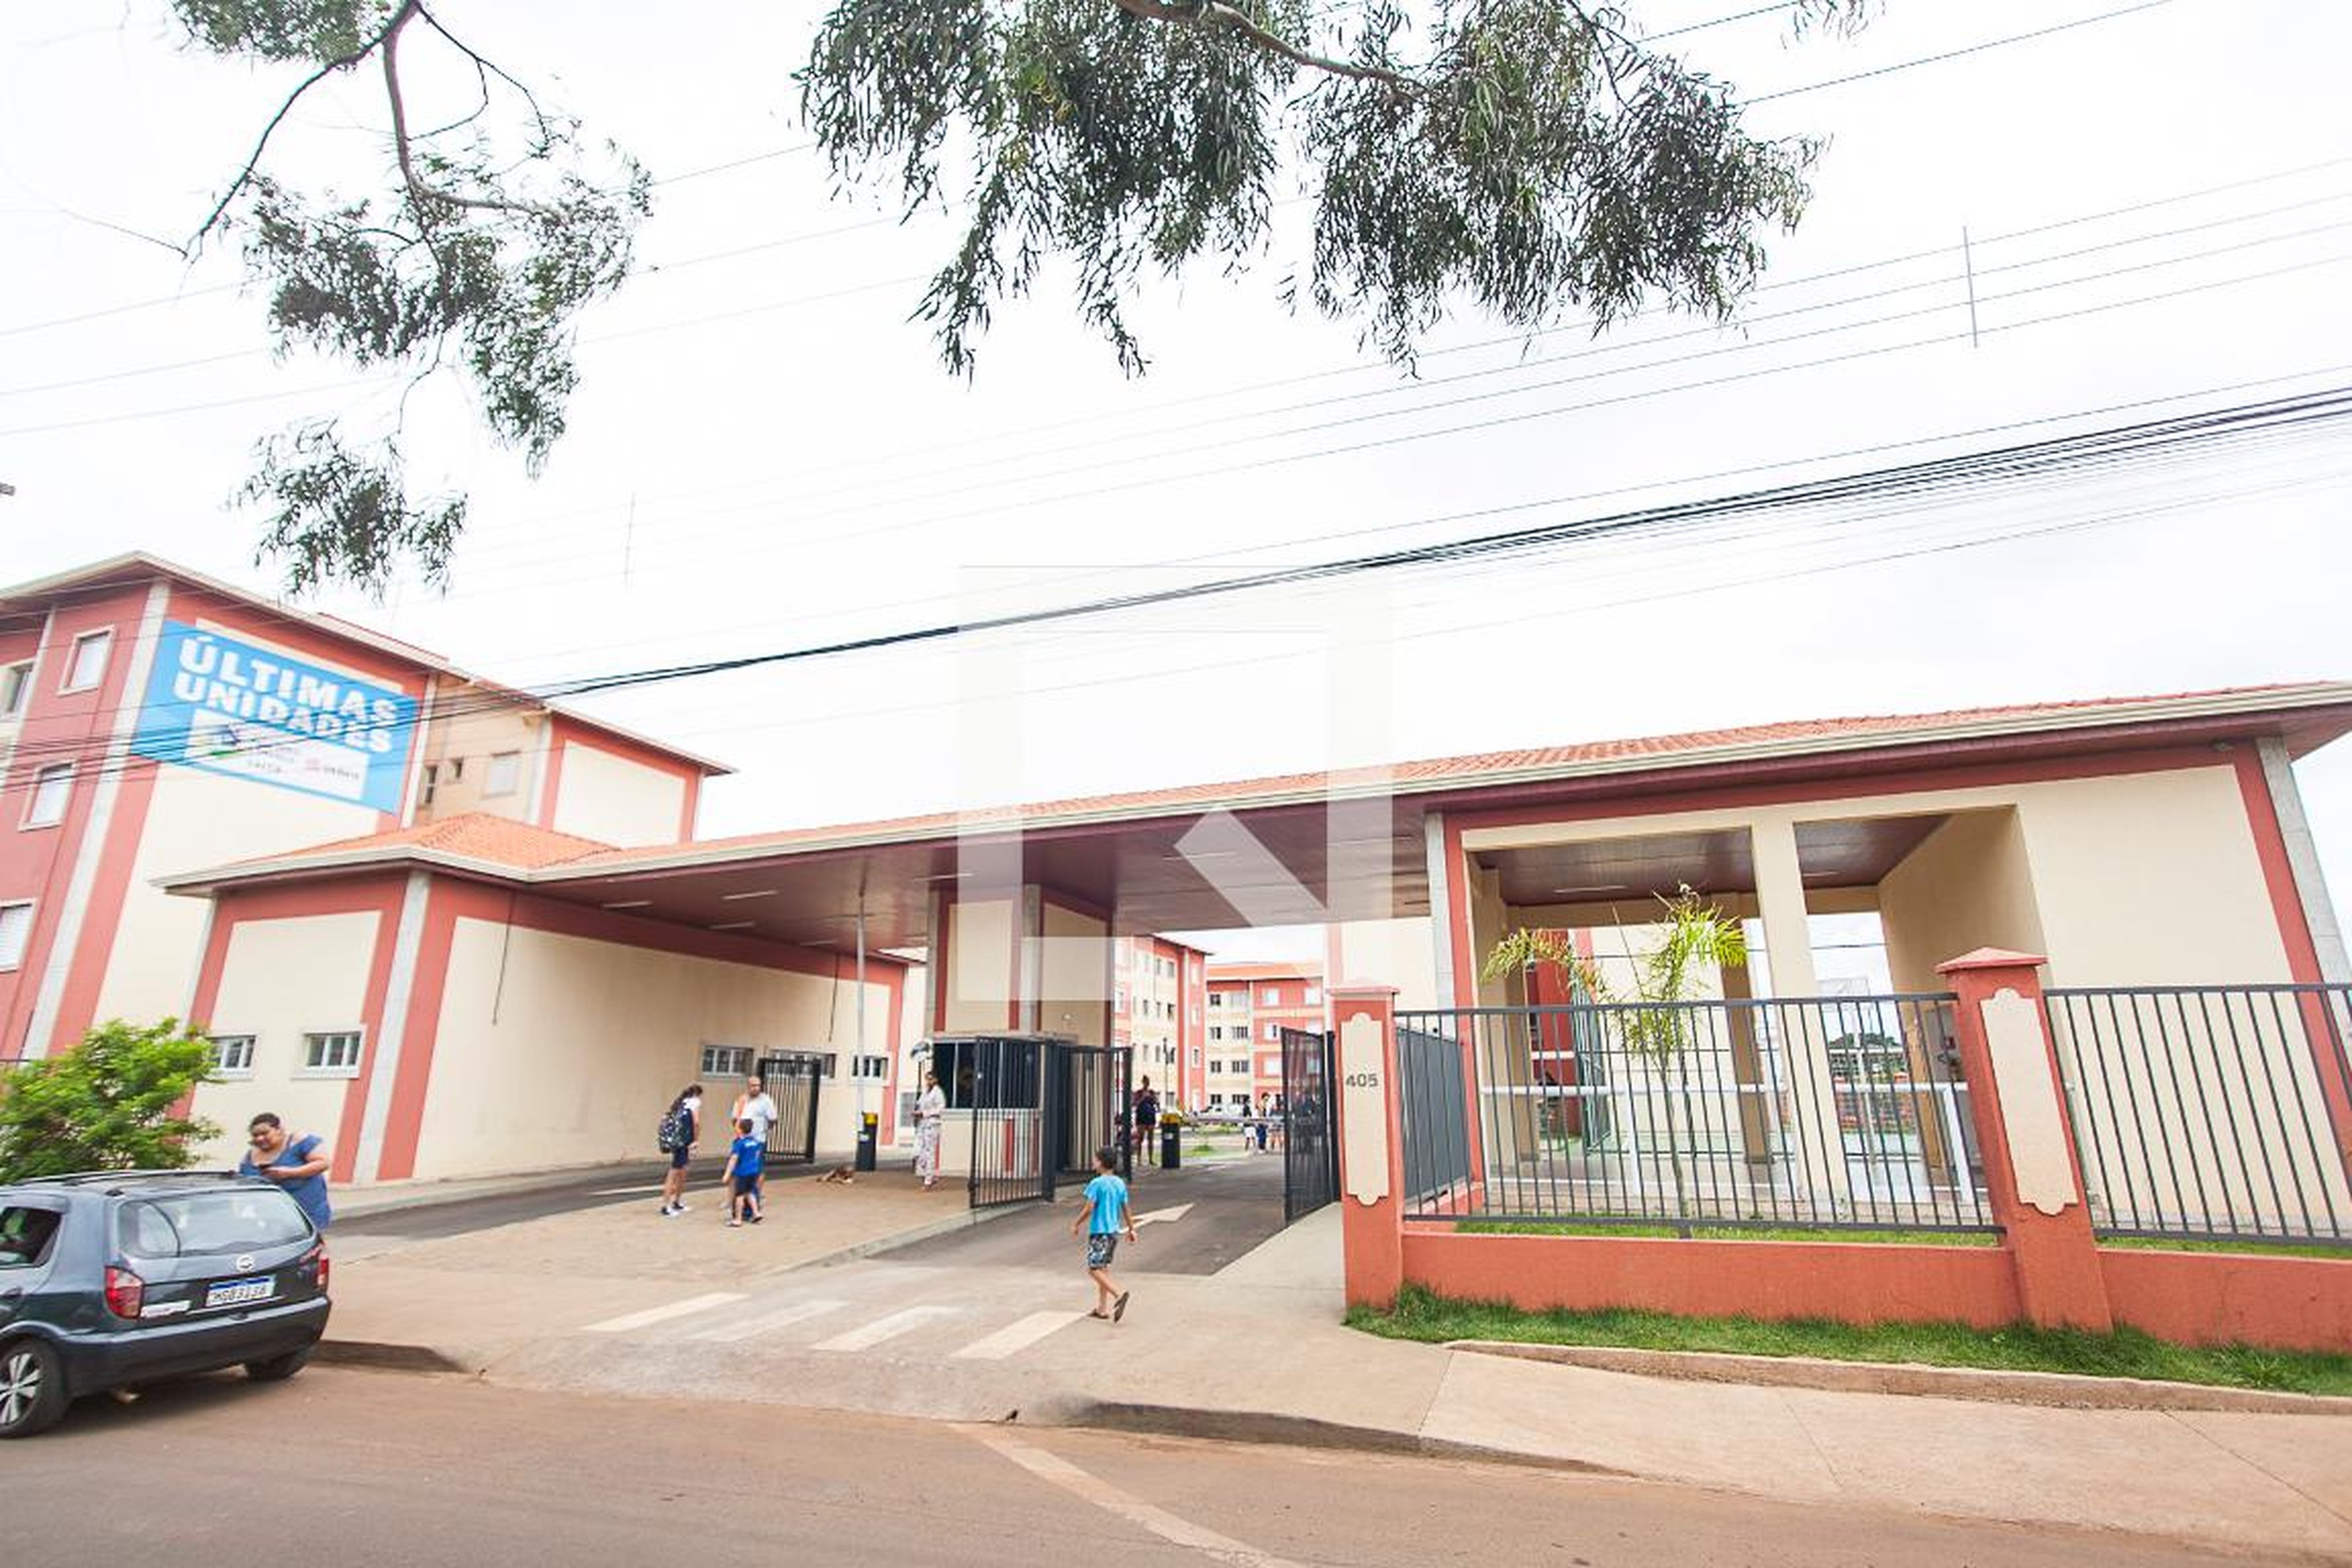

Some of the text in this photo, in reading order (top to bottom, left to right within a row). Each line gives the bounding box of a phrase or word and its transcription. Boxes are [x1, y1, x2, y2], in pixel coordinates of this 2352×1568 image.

[175, 671, 392, 753] UNIDADES
[180, 636, 397, 720] ÚLTIMAS
[1346, 1074, 1378, 1087] 405
